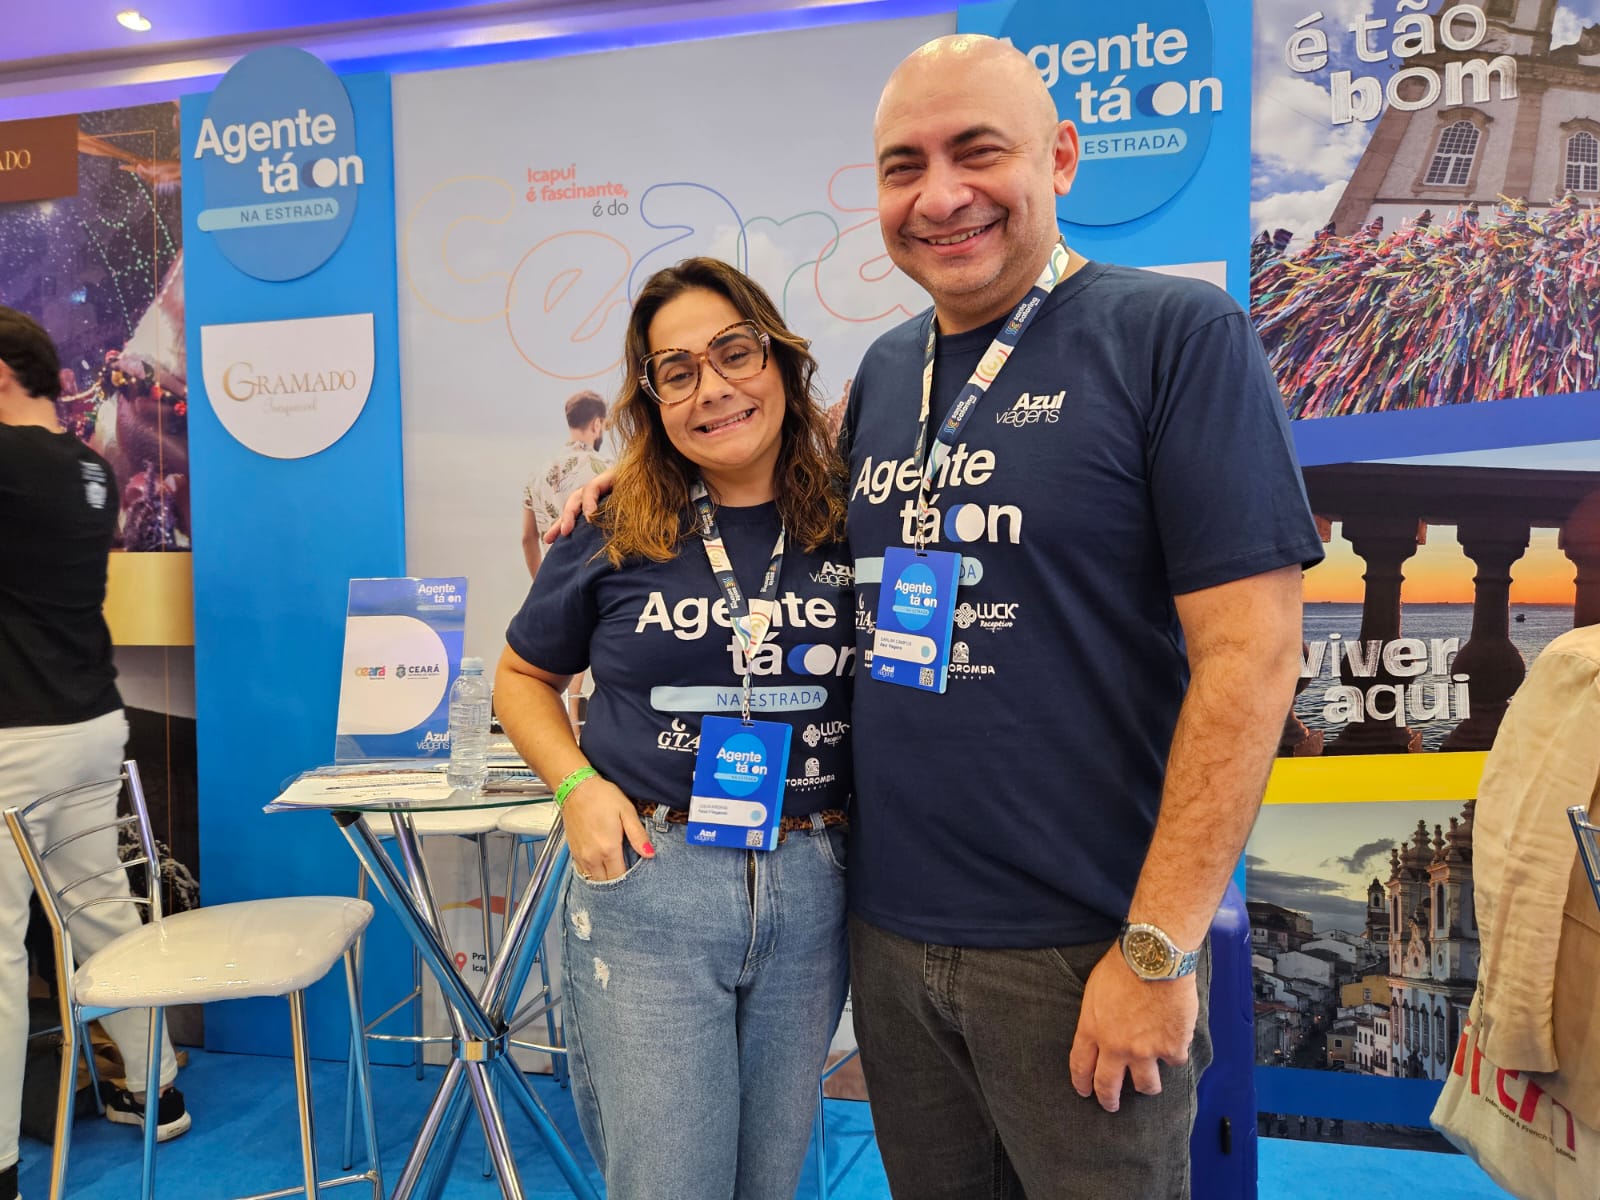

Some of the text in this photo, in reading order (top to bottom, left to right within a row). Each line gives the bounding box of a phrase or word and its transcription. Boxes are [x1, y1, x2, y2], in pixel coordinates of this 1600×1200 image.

[1285, 0, 1487, 73] é tão
[1000, 23, 1188, 88] gente
[1075, 74, 1132, 124] tá
[1330, 54, 1519, 125] bom
[193, 108, 337, 164] Agente
[1084, 133, 1180, 155] ESTRADA
[258, 152, 299, 194] tá
[540, 181, 630, 202] fascinante,
[240, 201, 335, 223] NA ESTRADA
[592, 198, 629, 218] é do
[1012, 390, 1066, 411] Azul
[996, 407, 1060, 428] viagens
[821, 560, 855, 578] Azu
[417, 582, 456, 596] Agente
[894, 579, 933, 595] Agente
[433, 592, 445, 604] tá
[909, 594, 920, 605] tá
[977, 603, 1020, 620] LUCK
[408, 663, 440, 674] CEARÁ
[948, 663, 996, 675] OROMBA
[716, 690, 822, 707] NA ESTRADA
[1321, 673, 1471, 728] aqui
[424, 730, 450, 742] Azul
[657, 720, 850, 749] GTA LUCK
[416, 740, 450, 752] viagens
[716, 746, 762, 763] Agente
[735, 762, 749, 774] tá
